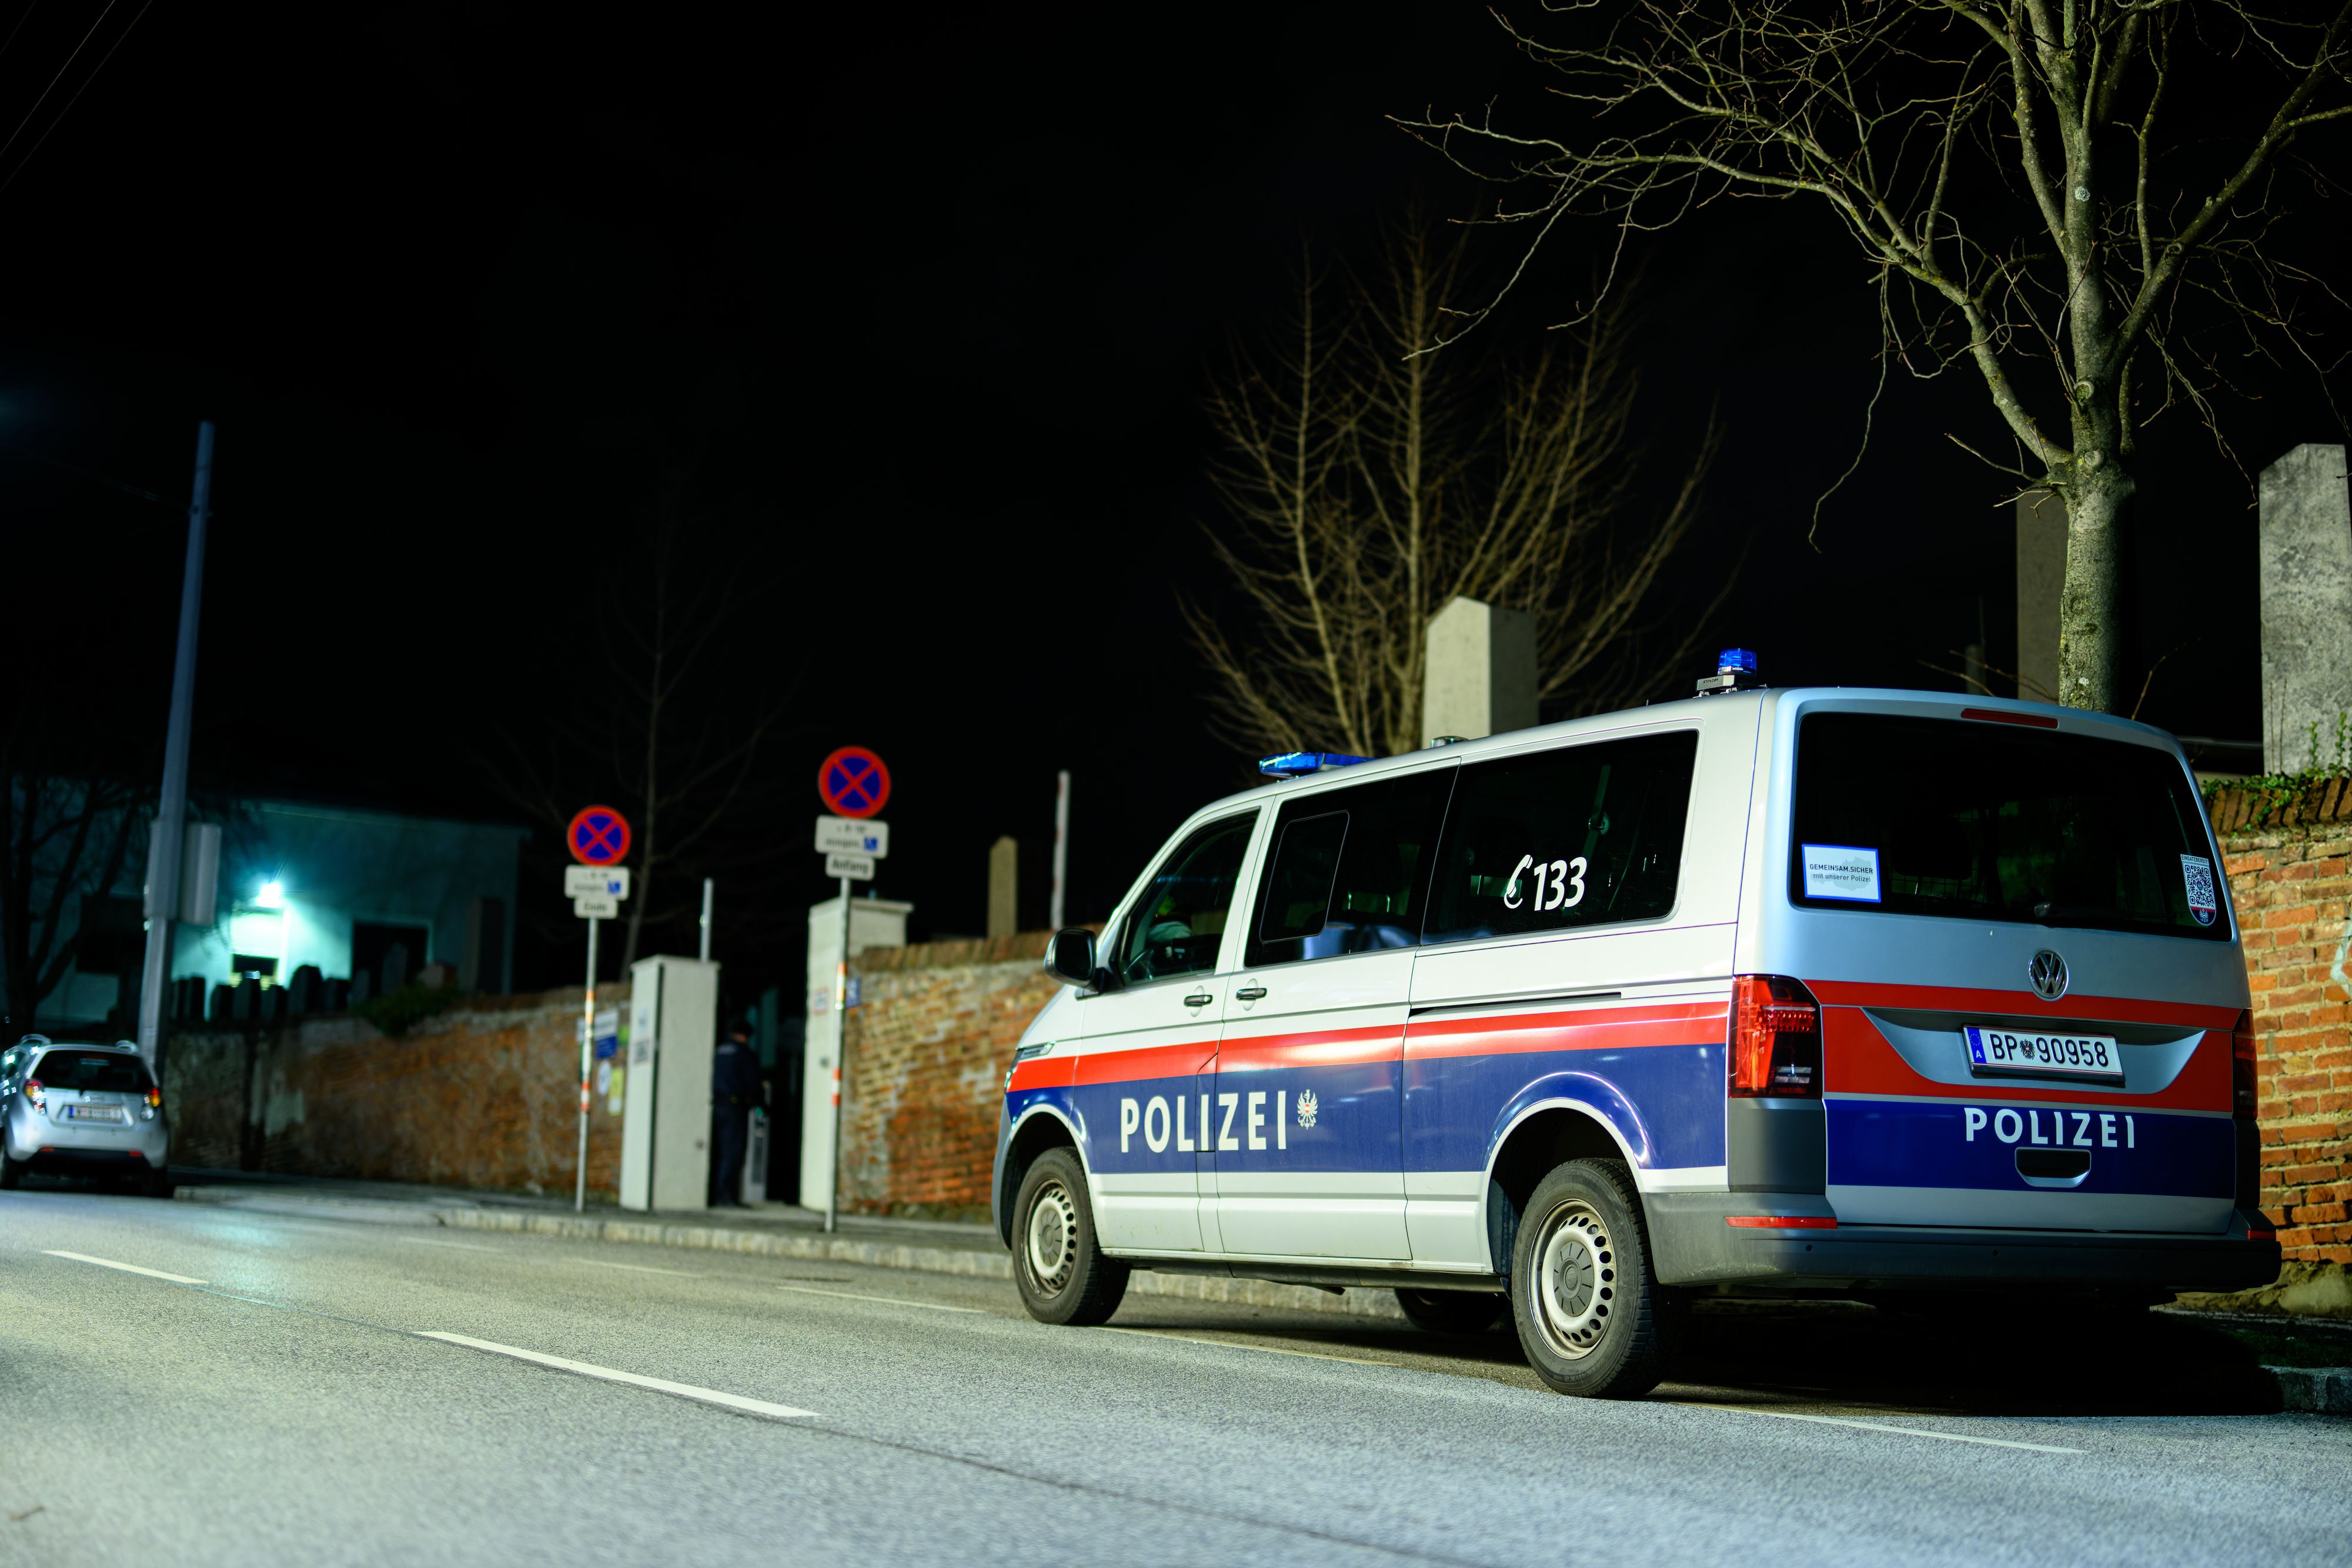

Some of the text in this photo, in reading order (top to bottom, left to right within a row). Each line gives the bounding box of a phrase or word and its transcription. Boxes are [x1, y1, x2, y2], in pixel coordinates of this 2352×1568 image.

[1534, 857, 1587, 911] 133
[1809, 864, 1873, 874] GEMEINSAM.SICHER
[1976, 1033, 2109, 1067] A BP 90958
[1121, 1091, 1287, 1154] POLIZEI
[1964, 1107, 2134, 1149] POLIZEI
